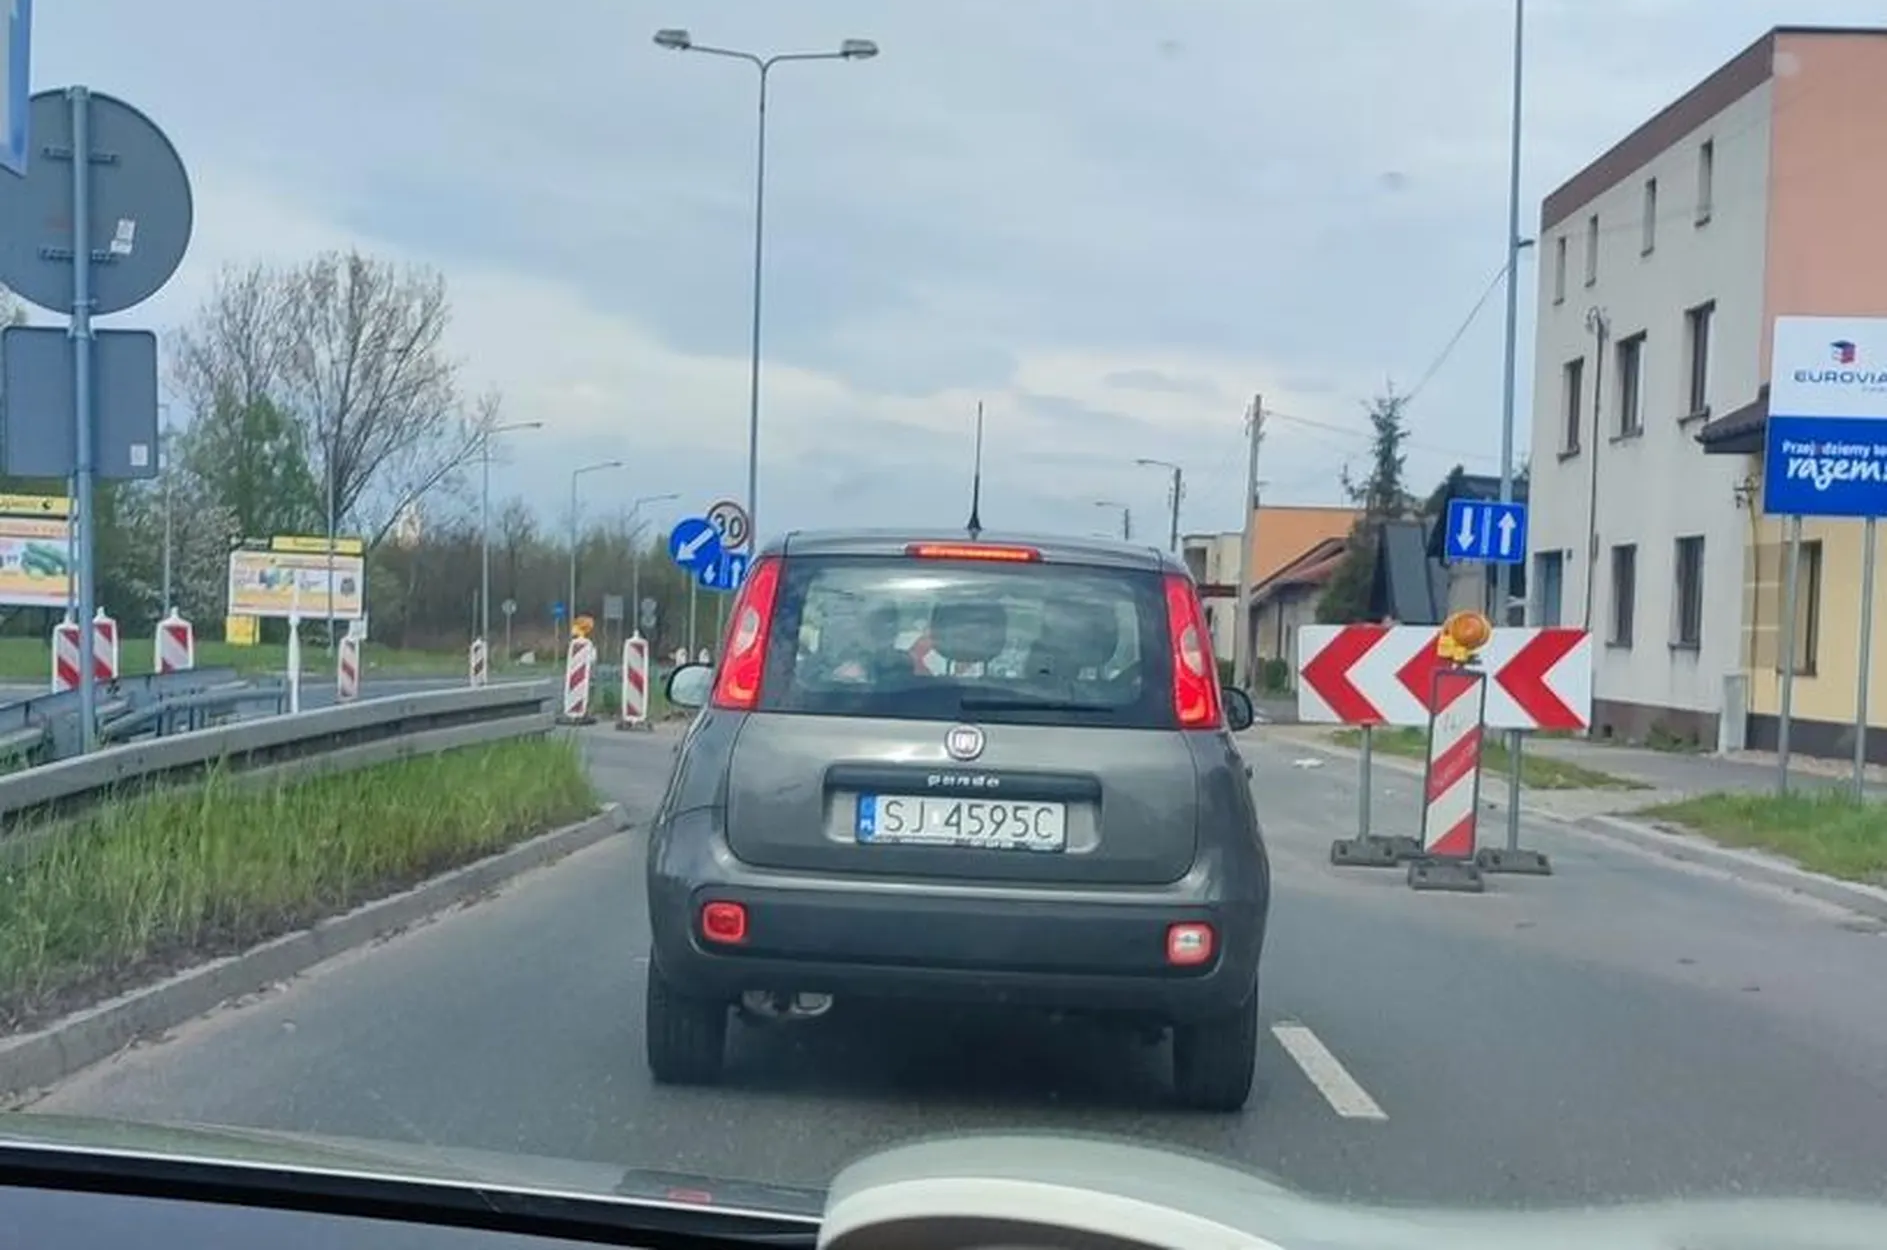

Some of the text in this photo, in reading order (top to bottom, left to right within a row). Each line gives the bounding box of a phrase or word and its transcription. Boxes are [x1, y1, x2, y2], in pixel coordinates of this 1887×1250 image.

[714, 512, 743, 539] 30
[884, 800, 1054, 840] SJ 4595C
